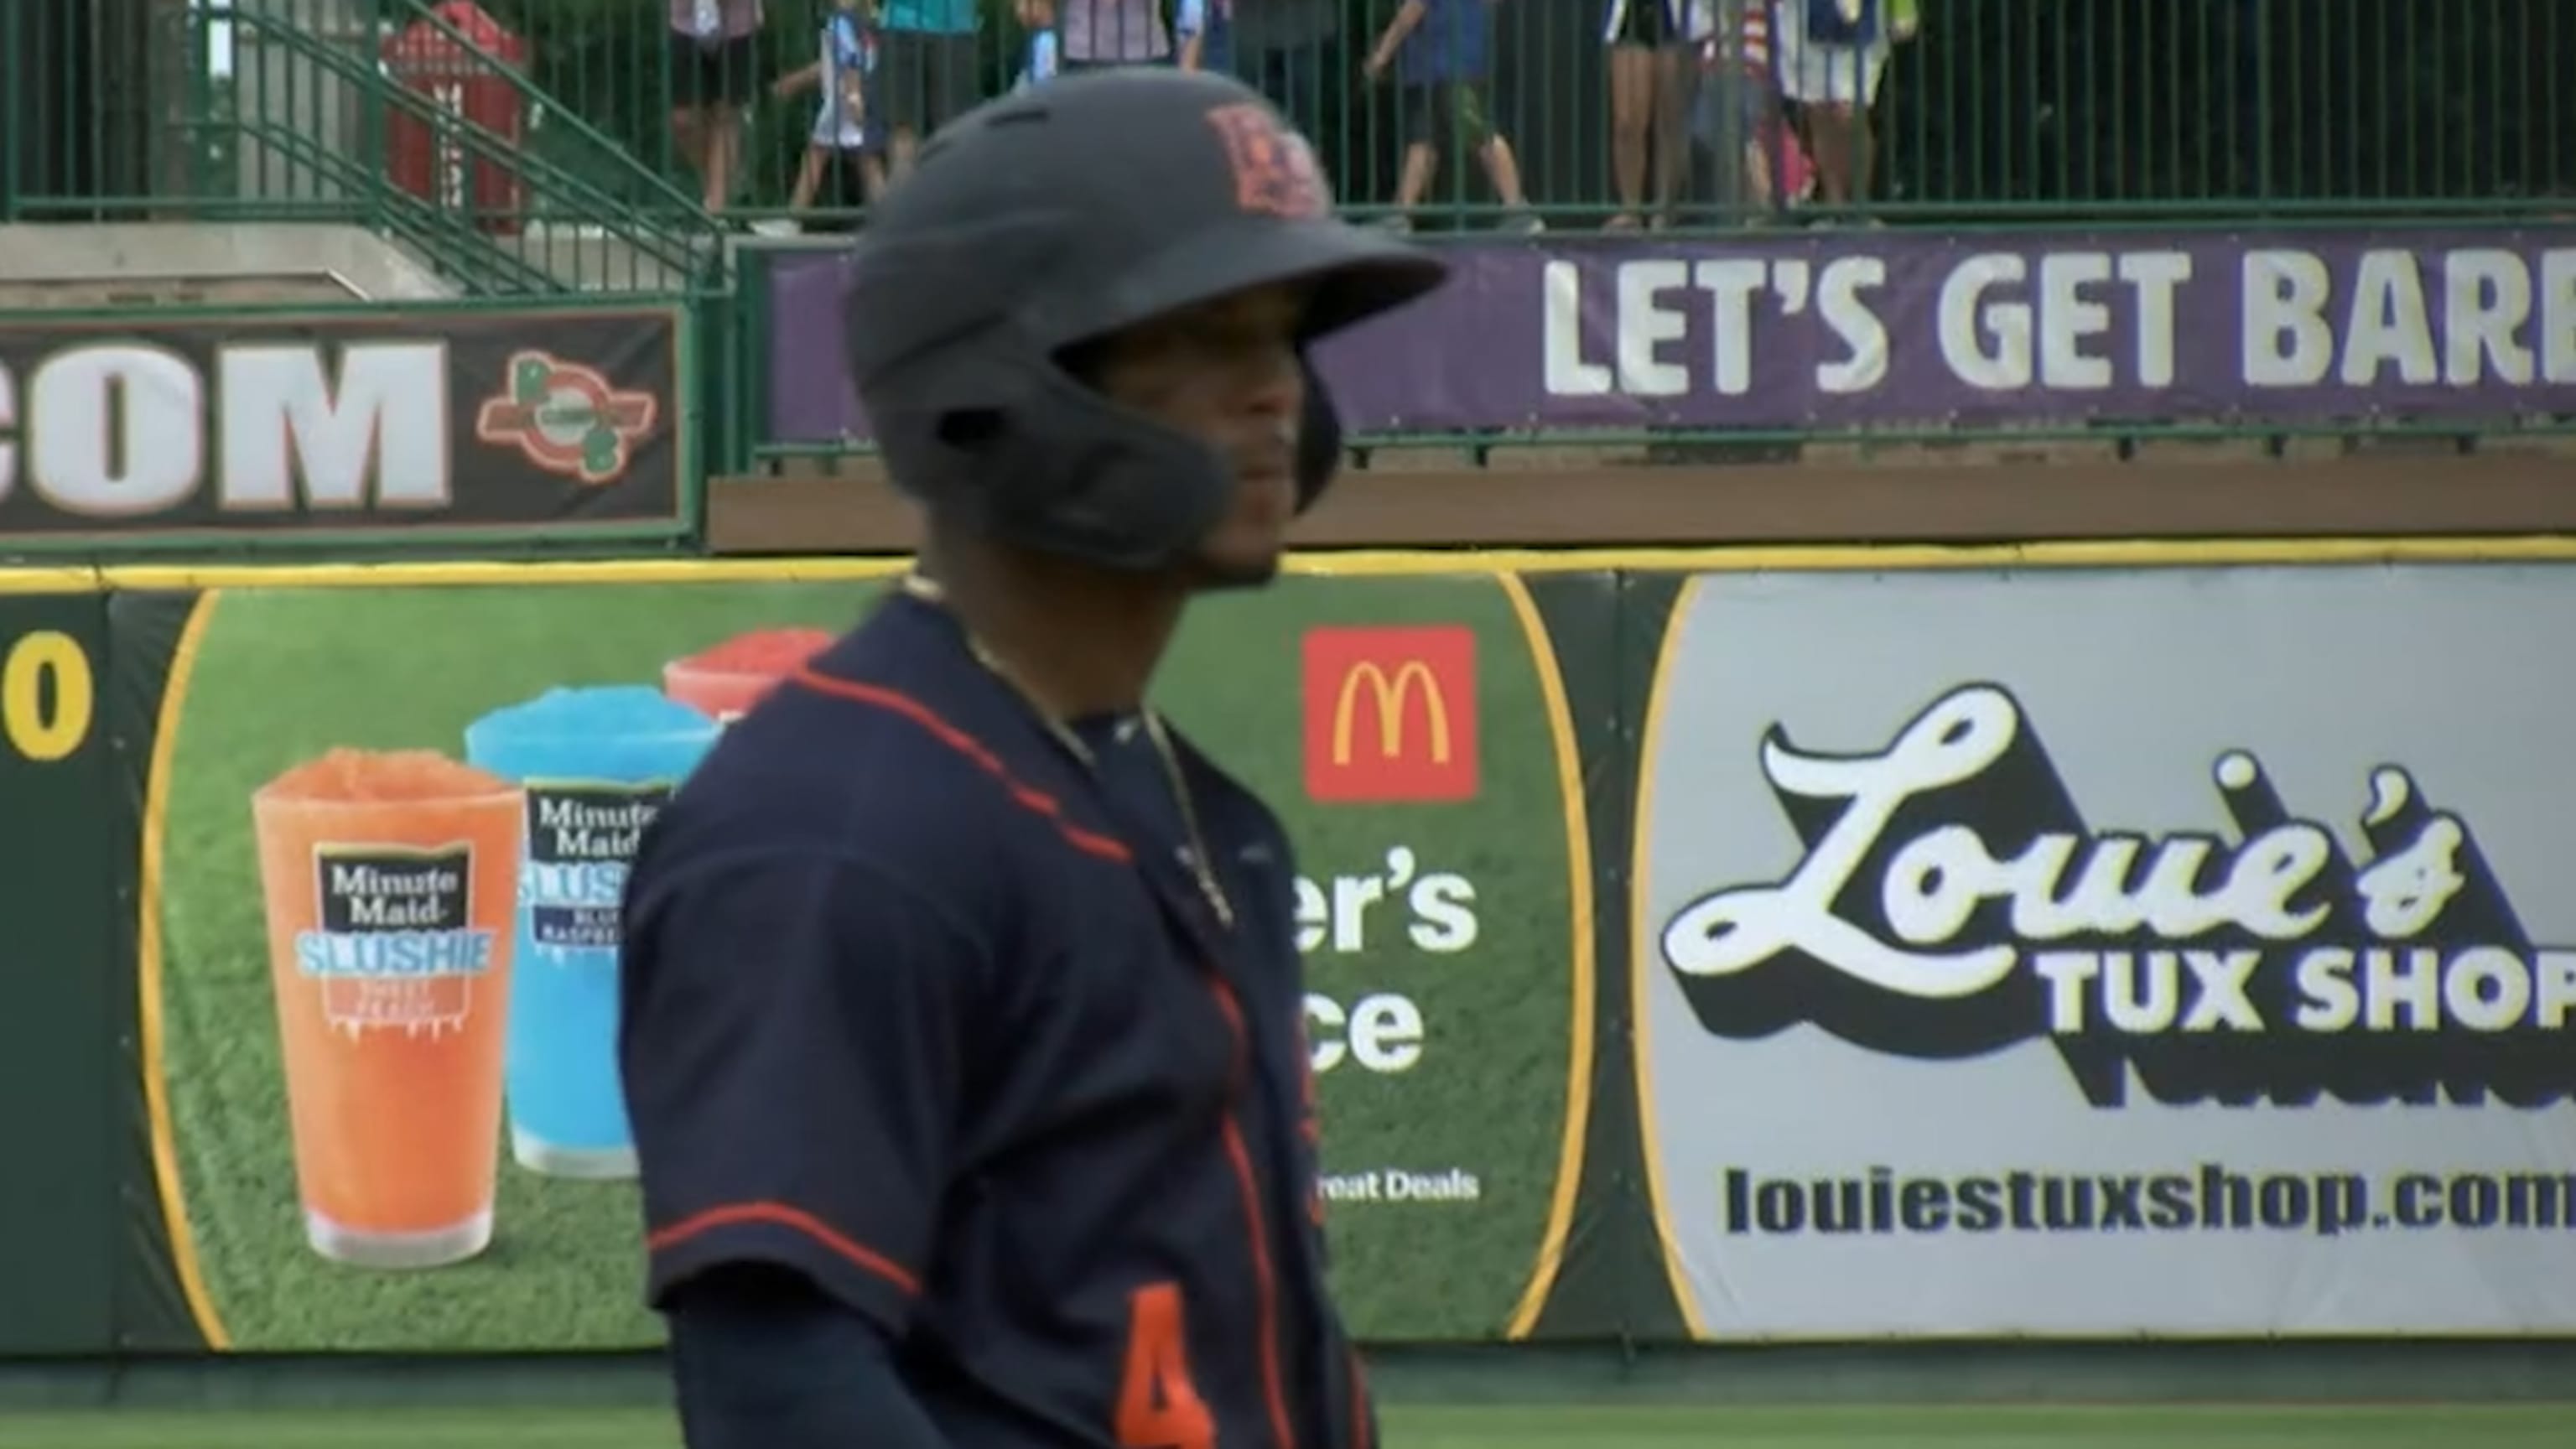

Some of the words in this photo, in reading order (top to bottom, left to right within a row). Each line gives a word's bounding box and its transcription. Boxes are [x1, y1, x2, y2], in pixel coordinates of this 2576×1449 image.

[1544, 257, 1889, 395] LET'S
[1938, 253, 2191, 389] GET
[0, 342, 451, 514] OM
[2, 629, 92, 761] 0
[332, 865, 459, 895] Minute
[1662, 683, 2465, 998] Louie's
[351, 896, 441, 924] Maid
[297, 928, 493, 976] SLUSHIE
[2035, 948, 2267, 1033] TUX
[2295, 946, 2576, 1033] SHOP
[1384, 1167, 1480, 1201] Deals
[1724, 1164, 2576, 1236] louiestuxshop.com
